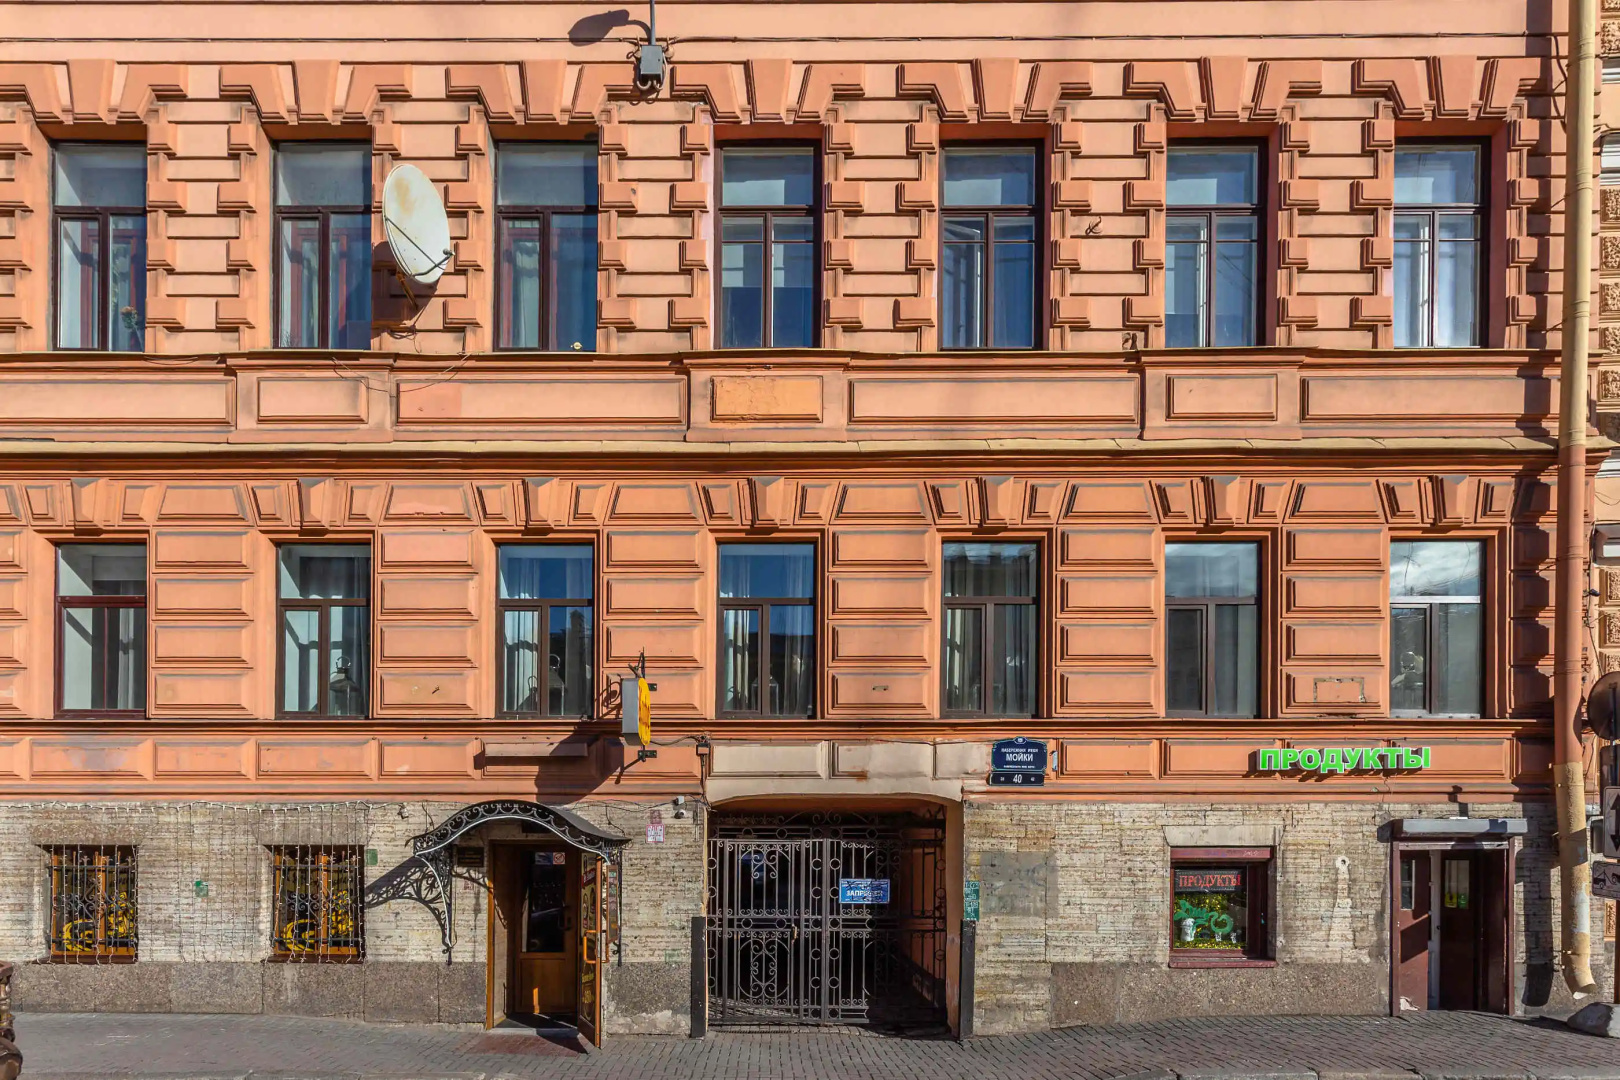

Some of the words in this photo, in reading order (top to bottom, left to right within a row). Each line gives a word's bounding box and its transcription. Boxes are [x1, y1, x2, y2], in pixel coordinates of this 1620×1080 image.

[1005, 753, 1034, 762] МОЙКИ
[1259, 747, 1431, 773] ПРОДУКТЫ
[1012, 774, 1022, 784] 40
[1179, 874, 1242, 888] ПРОДУКТЫ
